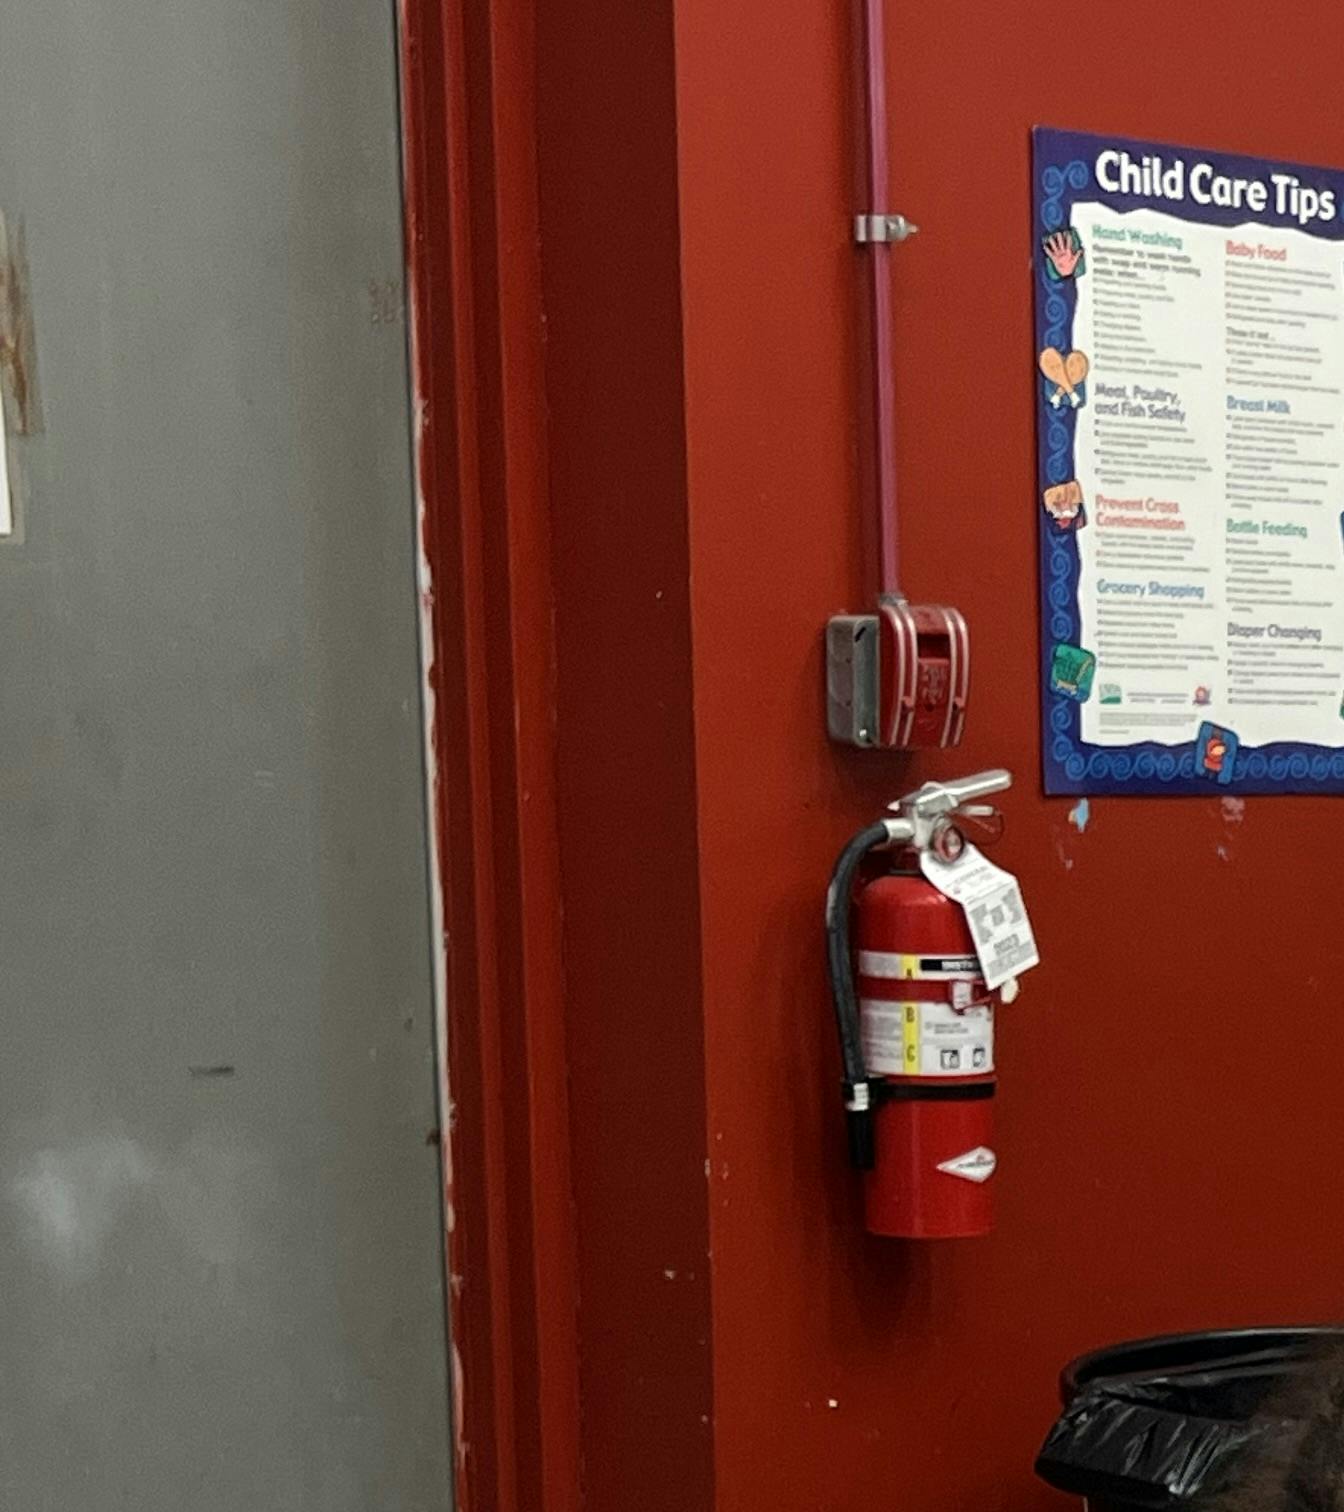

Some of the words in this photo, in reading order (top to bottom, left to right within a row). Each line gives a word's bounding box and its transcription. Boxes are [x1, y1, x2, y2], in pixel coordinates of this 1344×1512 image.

[1095, 150, 1184, 200] Child
[1190, 163, 1268, 212] Care
[1272, 174, 1336, 223] Tips
[1092, 224, 1126, 241] Hand
[1126, 228, 1183, 250] Washing
[1225, 240, 1256, 260] Baby
[1258, 244, 1287, 262] Food
[1121, 402, 1146, 417] Fish
[1148, 404, 1186, 424] Safety
[1095, 495, 1143, 513] Prevent
[1145, 497, 1179, 515] Cross
[1096, 512, 1185, 531] Contamination
[1262, 521, 1308, 539] Feeding
[1097, 578, 1146, 597] Grocery
[1148, 581, 1205, 599] Shopping
[1227, 622, 1266, 641] Diaper
[1267, 624, 1322, 642] Changing
